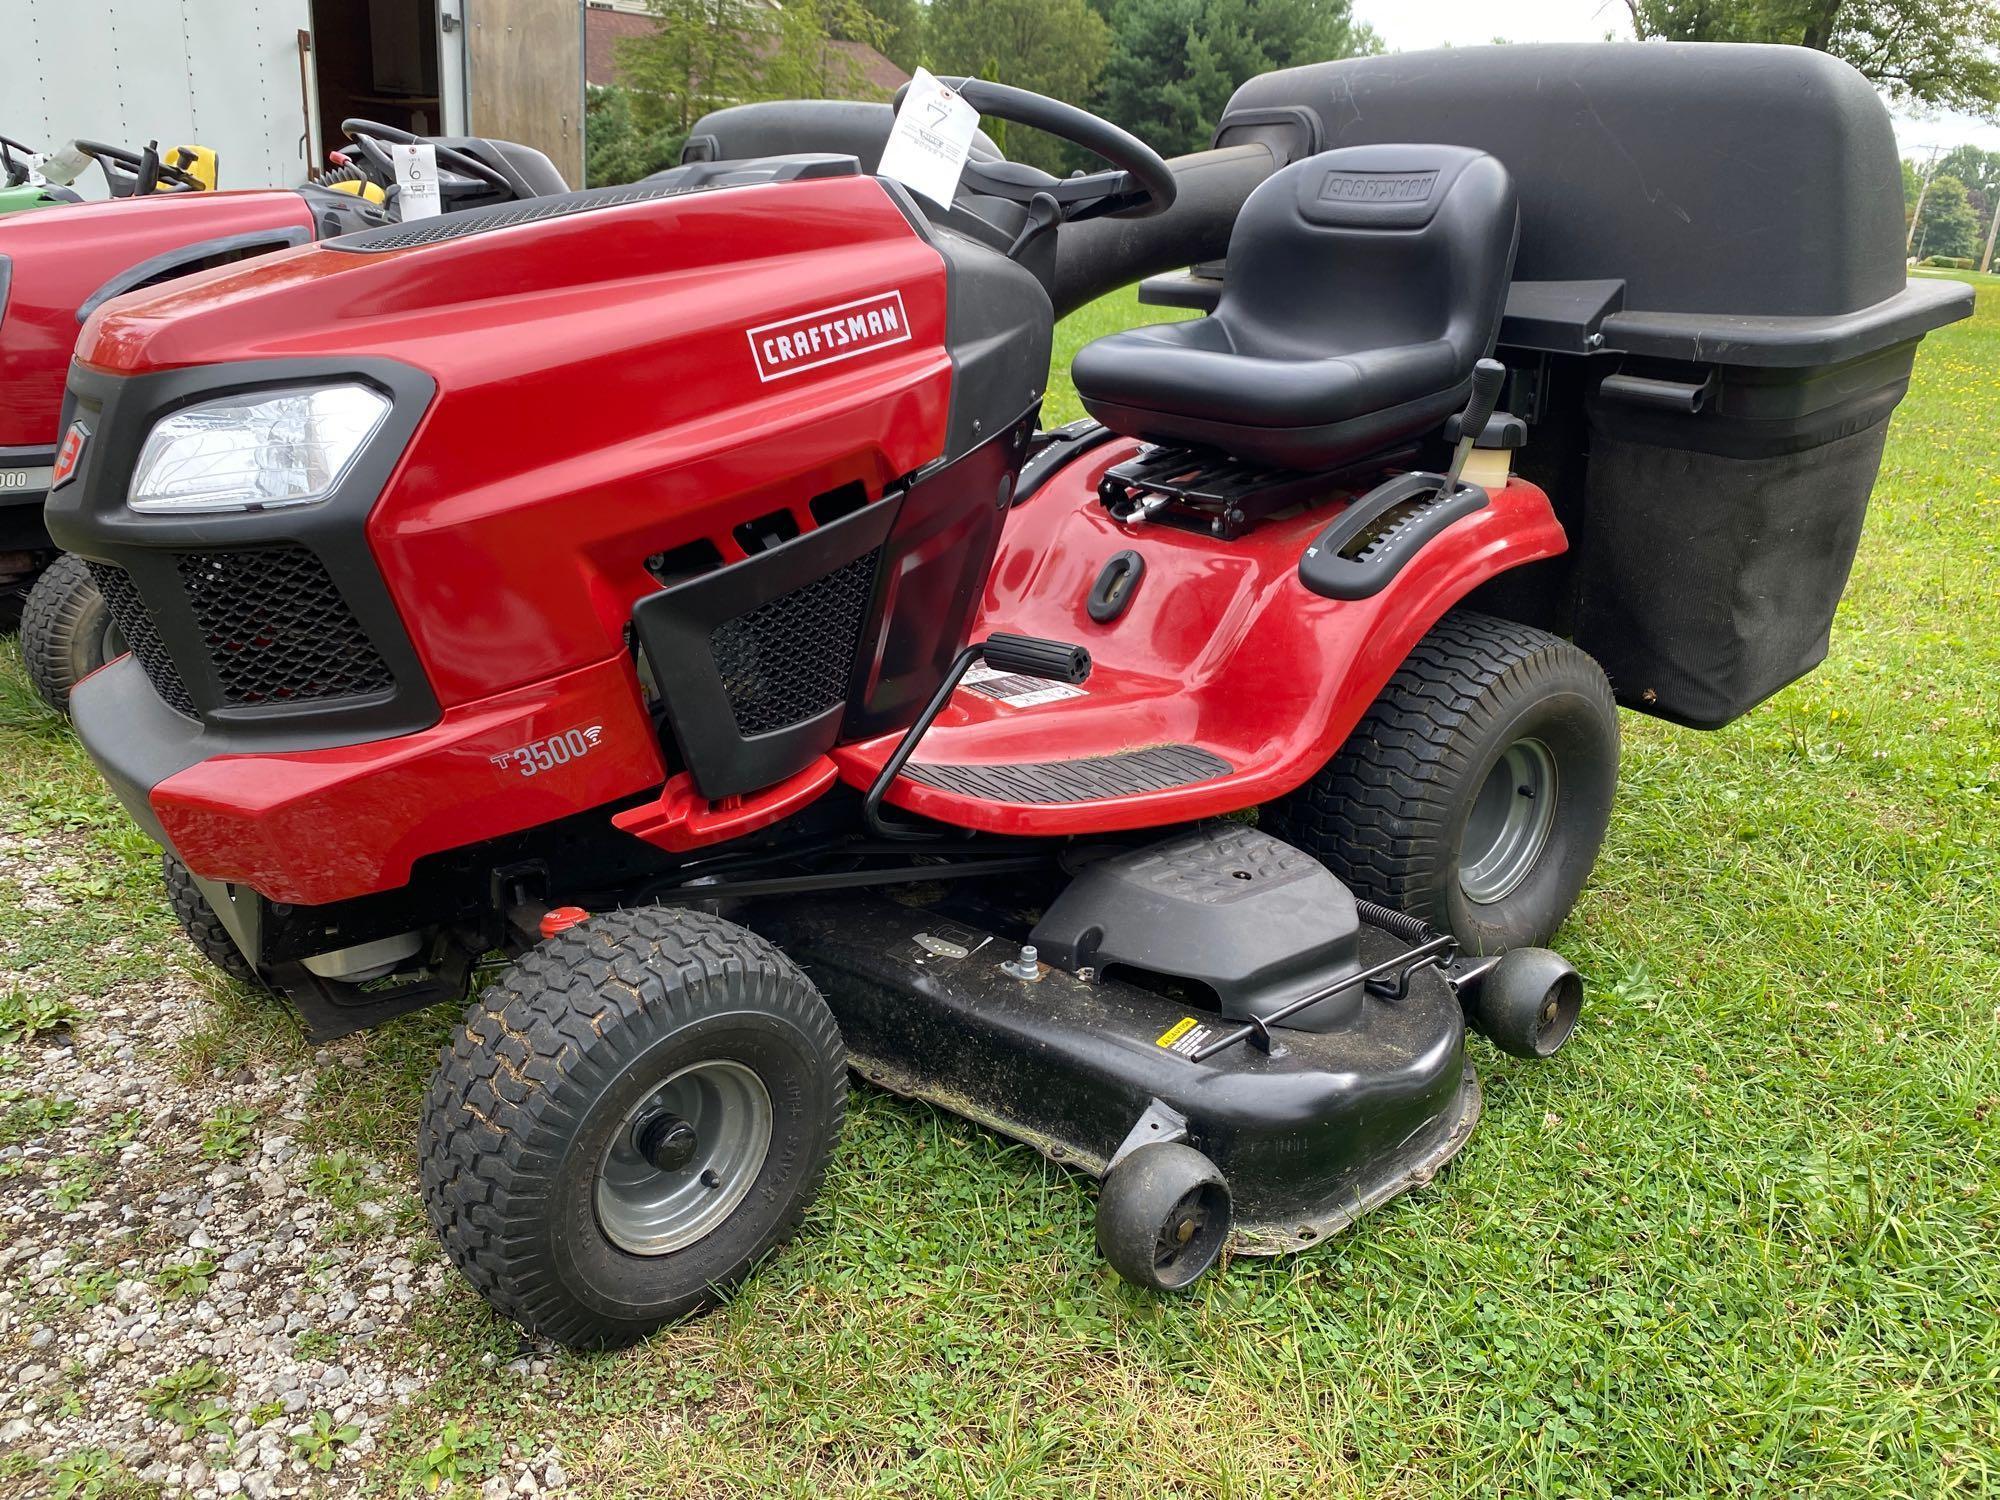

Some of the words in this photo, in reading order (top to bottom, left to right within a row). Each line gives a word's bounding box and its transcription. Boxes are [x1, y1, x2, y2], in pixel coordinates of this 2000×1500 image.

[926, 103, 948, 129] 7
[409, 162, 421, 180] 6
[1328, 177, 1432, 198] CRAFTSMAN
[762, 306, 899, 365] CRAFTSMAN
[1167, 1020, 1193, 1044] CAUTION
